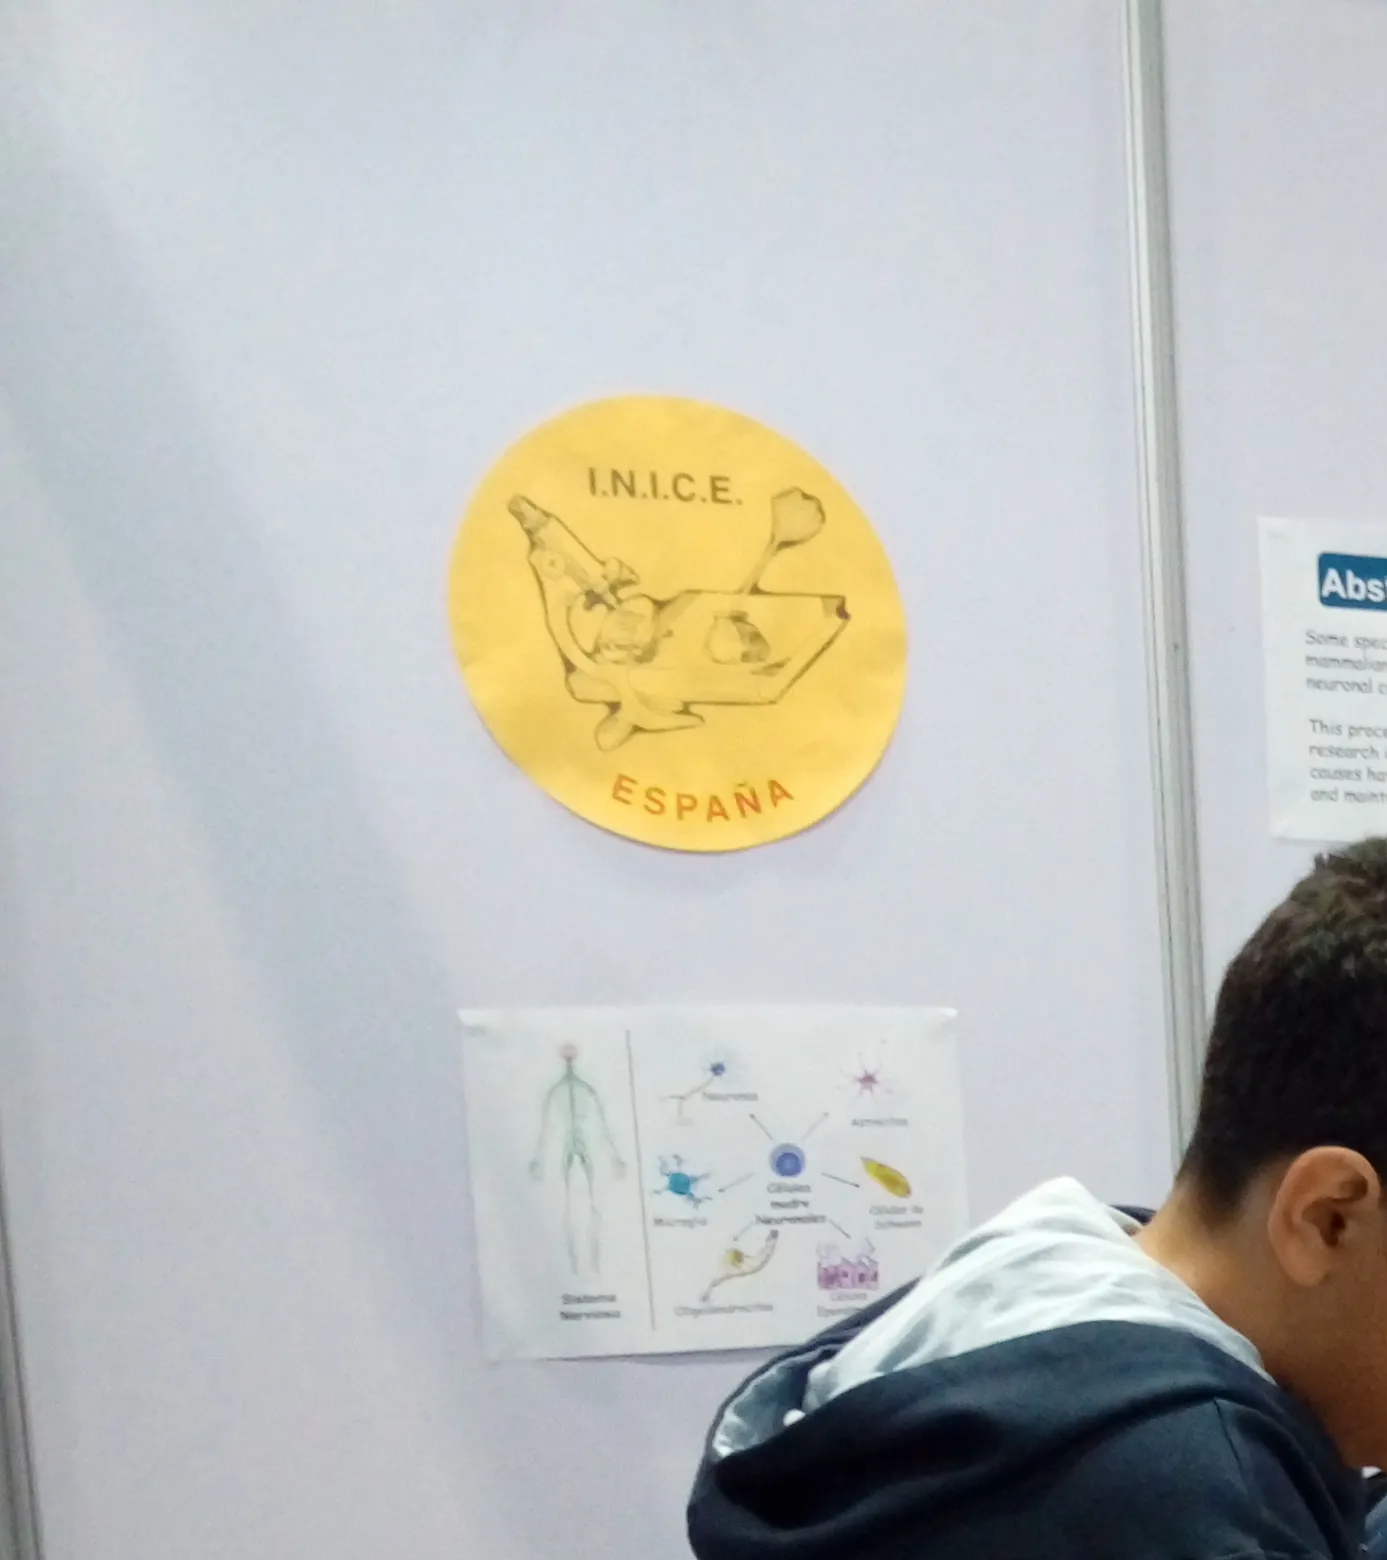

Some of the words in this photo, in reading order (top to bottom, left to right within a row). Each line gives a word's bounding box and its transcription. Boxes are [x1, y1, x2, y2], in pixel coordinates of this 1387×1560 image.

[588, 467, 744, 506] I.N.I.C.E.
[1305, 630, 1349, 648] Some
[1306, 677, 1372, 694] neuronal
[1309, 719, 1342, 736] This
[612, 773, 794, 823] ESPAÑA
[1311, 787, 1338, 802] and
